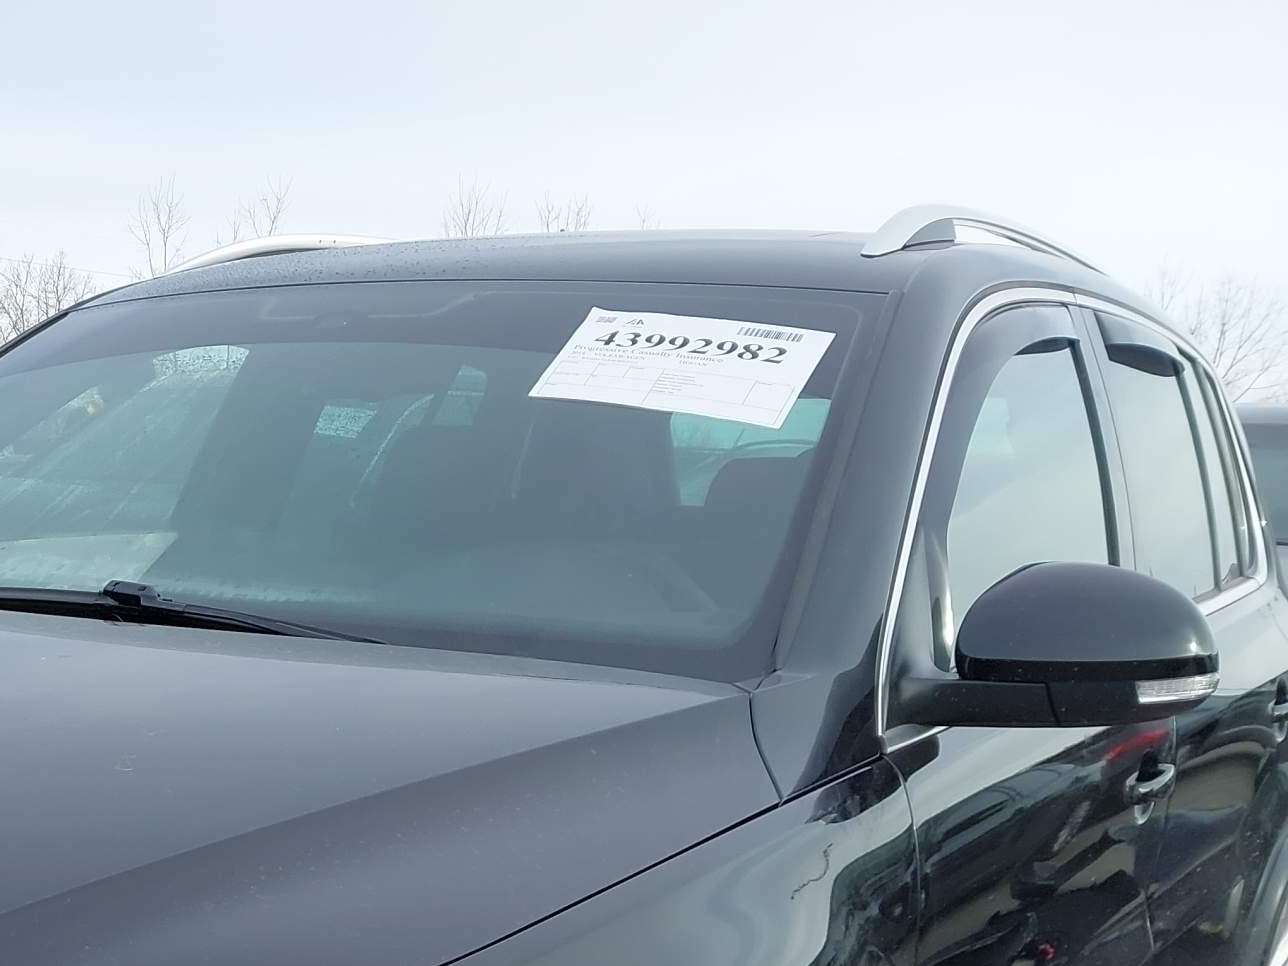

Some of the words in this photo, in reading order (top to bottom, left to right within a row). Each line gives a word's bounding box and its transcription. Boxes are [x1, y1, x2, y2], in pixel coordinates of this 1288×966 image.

[574, 344, 630, 354] Progressive
[675, 352, 724, 363] Insurance
[593, 330, 787, 364] 43992982
